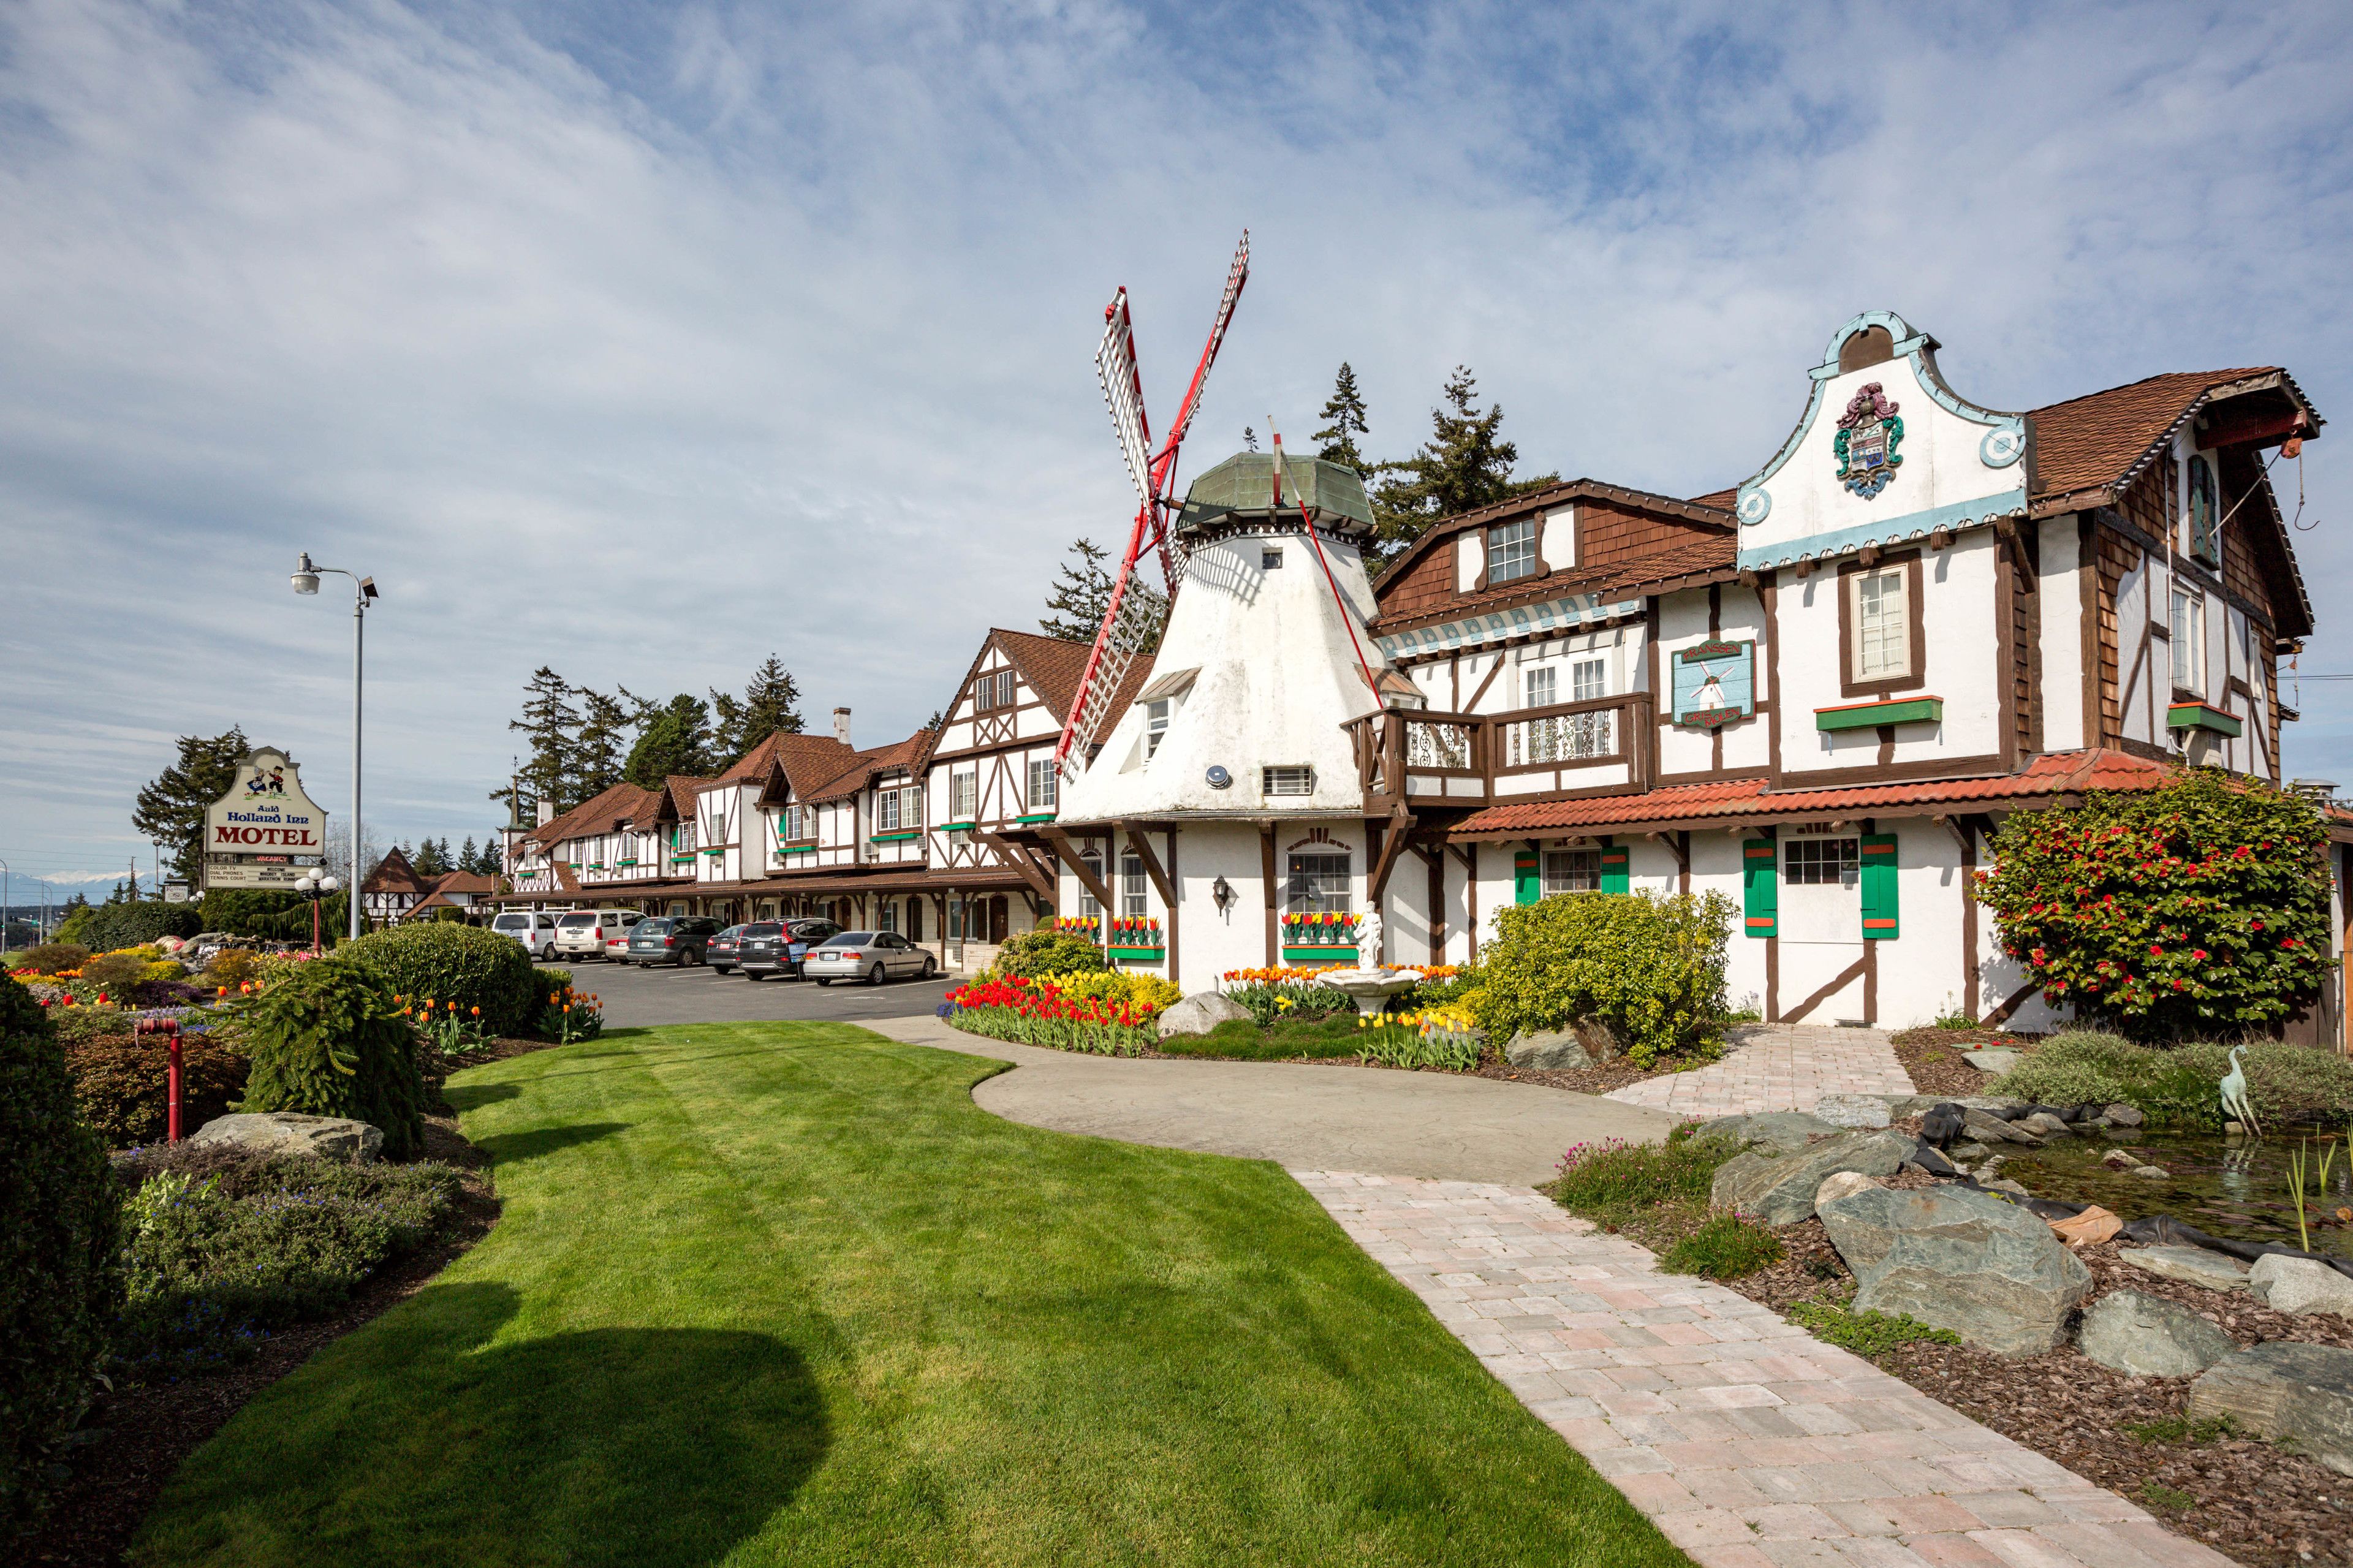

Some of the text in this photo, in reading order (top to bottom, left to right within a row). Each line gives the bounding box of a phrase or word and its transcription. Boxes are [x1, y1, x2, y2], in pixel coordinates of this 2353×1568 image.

[1683, 643, 1740, 660] FRANSSEN
[1686, 710, 1711, 723] GRIS
[1705, 708, 1740, 728] MOLEN
[227, 812, 309, 824] Holland Inn
[214, 826, 317, 846] MOTEL
